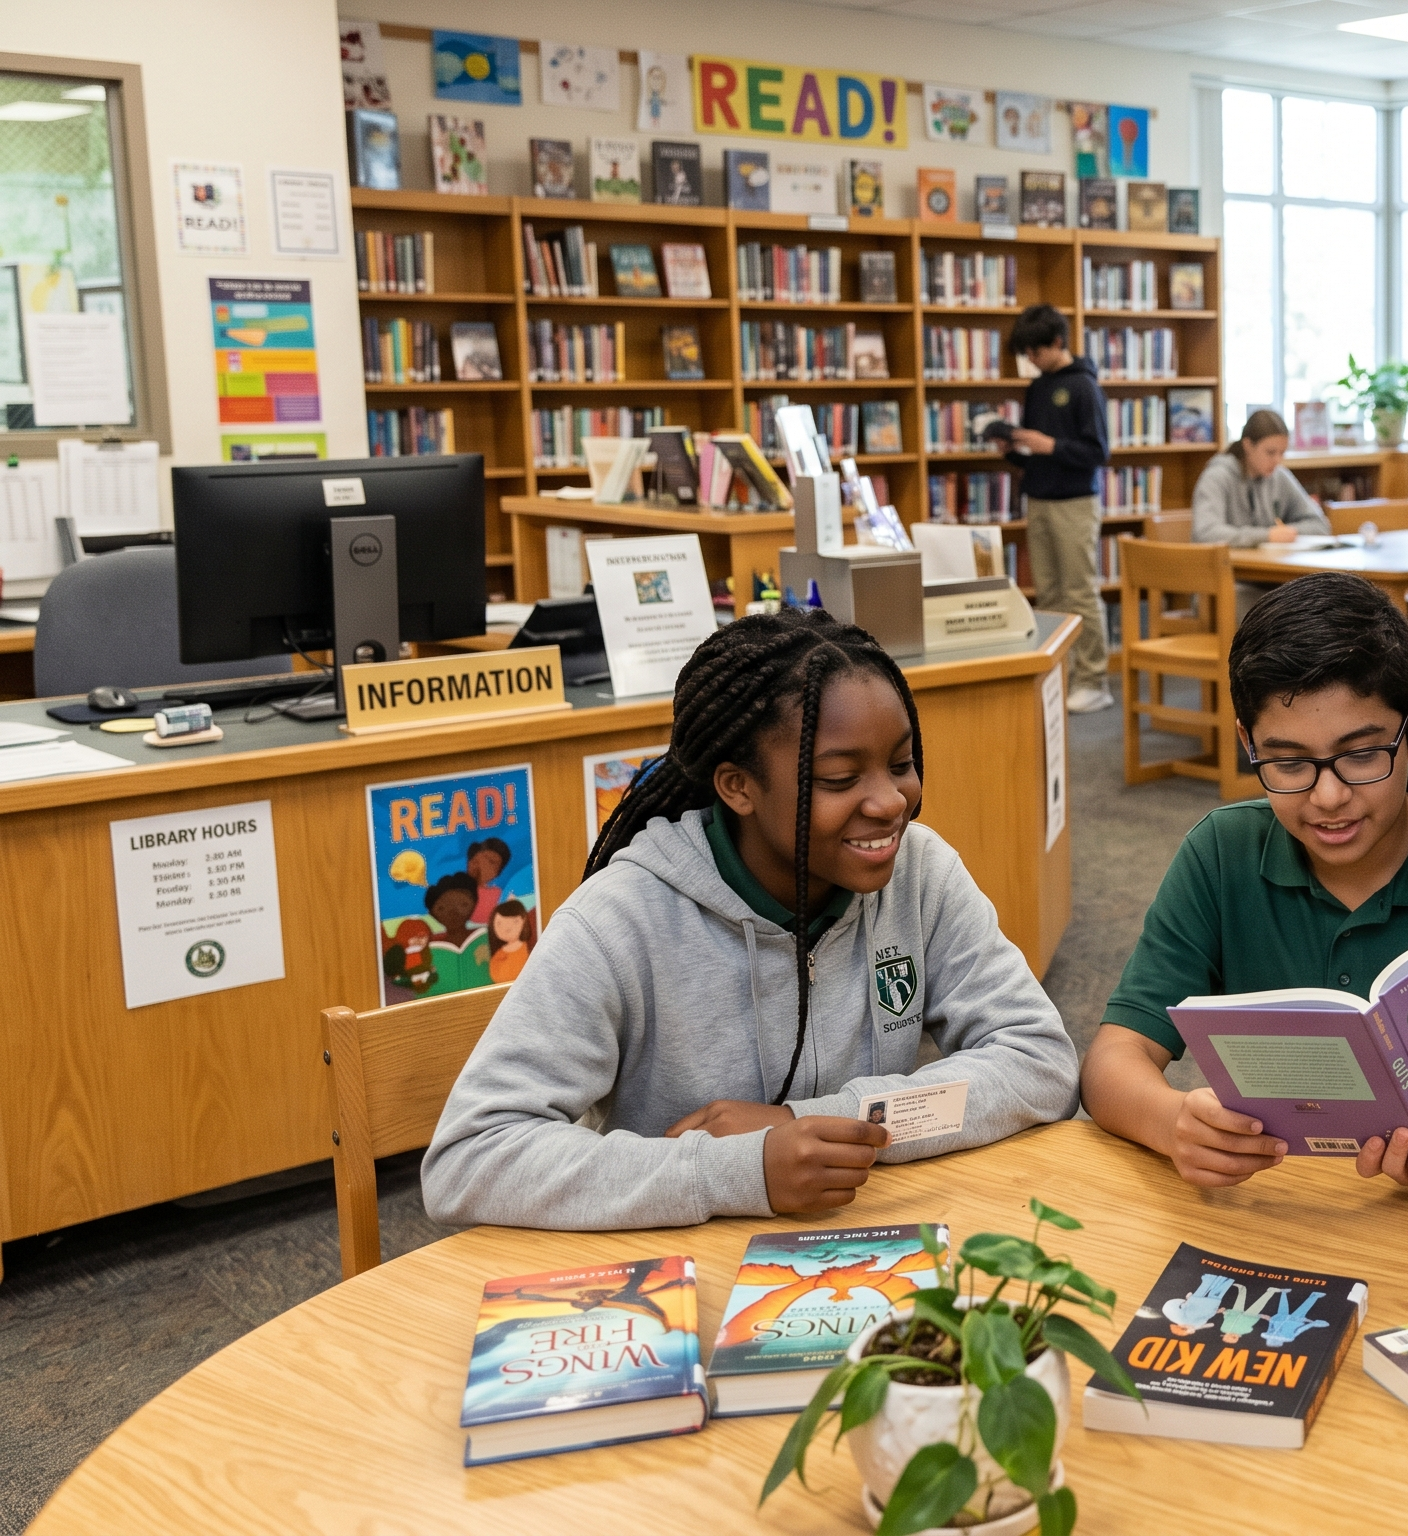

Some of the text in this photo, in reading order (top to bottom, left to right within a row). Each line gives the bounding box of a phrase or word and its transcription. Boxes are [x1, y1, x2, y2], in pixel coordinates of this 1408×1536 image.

[701, 61, 897, 143] READ!
[185, 217, 238, 231] READ!
[357, 665, 554, 711] INFORMATION
[130, 819, 258, 851] LIBRARY HOURS
[389, 783, 517, 843] READ!
[530, 1317, 637, 1354] FIRE
[501, 1343, 669, 1385] WINGS
[1128, 1337, 1308, 1388] NEW KID
